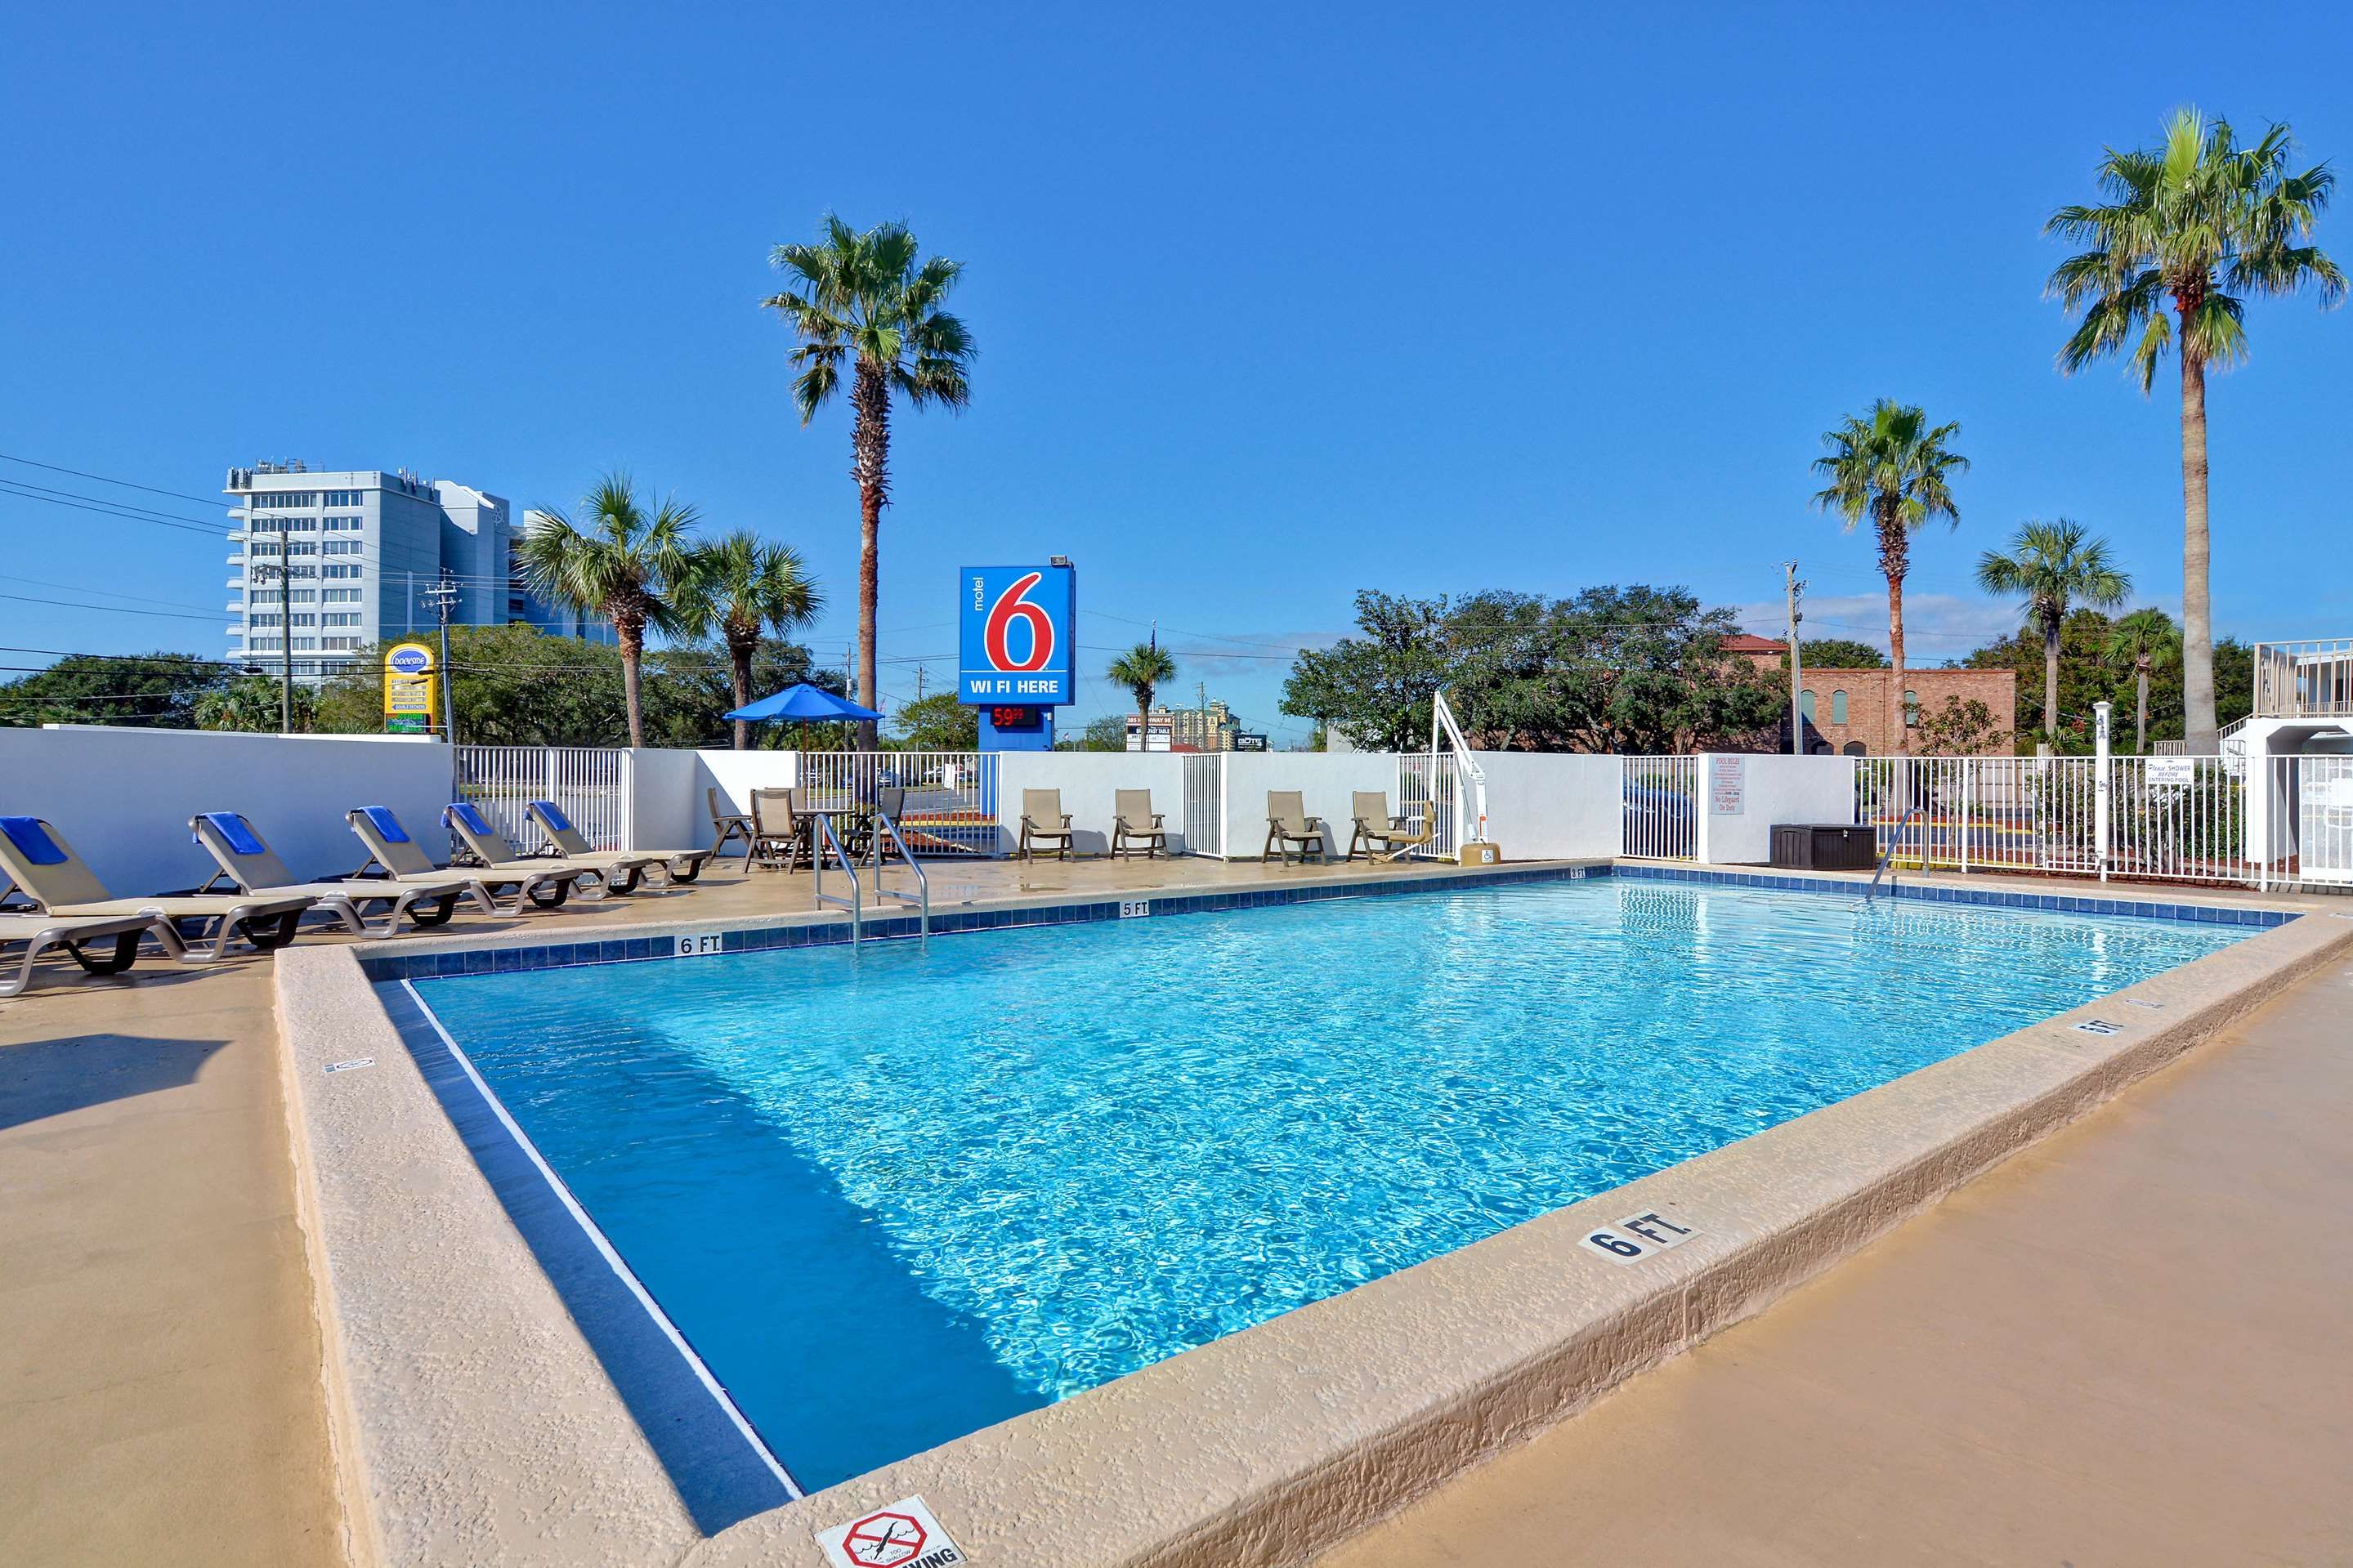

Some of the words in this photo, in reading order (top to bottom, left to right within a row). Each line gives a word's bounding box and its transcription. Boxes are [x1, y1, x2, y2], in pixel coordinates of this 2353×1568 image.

[973, 577, 983, 611] motel
[984, 572, 1054, 672] 6
[395, 657, 425, 665] DOCKSIDE
[970, 680, 991, 694] WI
[996, 680, 1010, 694] FI
[1017, 680, 1058, 694] HERE
[1572, 869, 1577, 878] 3
[1124, 903, 1131, 915] 5
[681, 938, 692, 954] 6
[1590, 1234, 1642, 1257] 6
